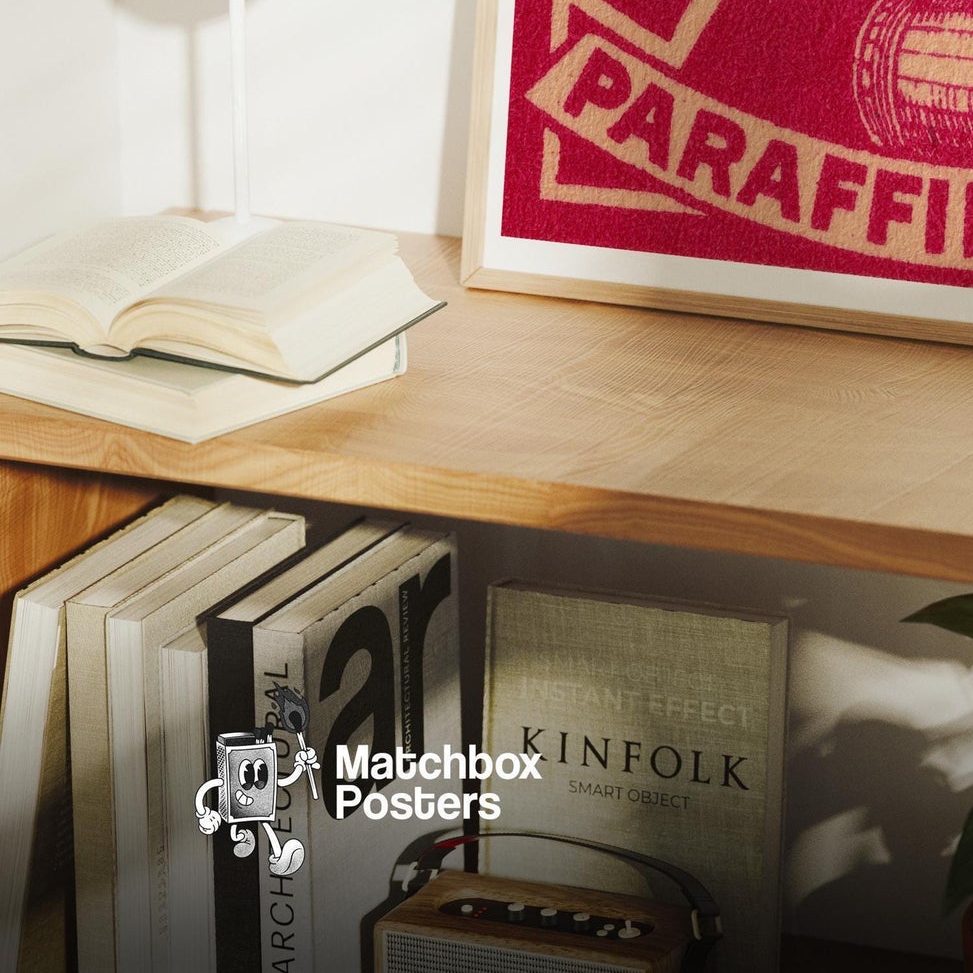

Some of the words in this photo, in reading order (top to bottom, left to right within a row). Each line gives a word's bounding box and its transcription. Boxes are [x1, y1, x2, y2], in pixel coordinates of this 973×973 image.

[401, 589, 410, 643] REVIEW
[318, 551, 452, 821] ar
[650, 693, 752, 728] EFFECT
[521, 725, 751, 791] KINFOLK
[568, 779, 625, 801] SMART
[627, 787, 691, 810] OBJECT
